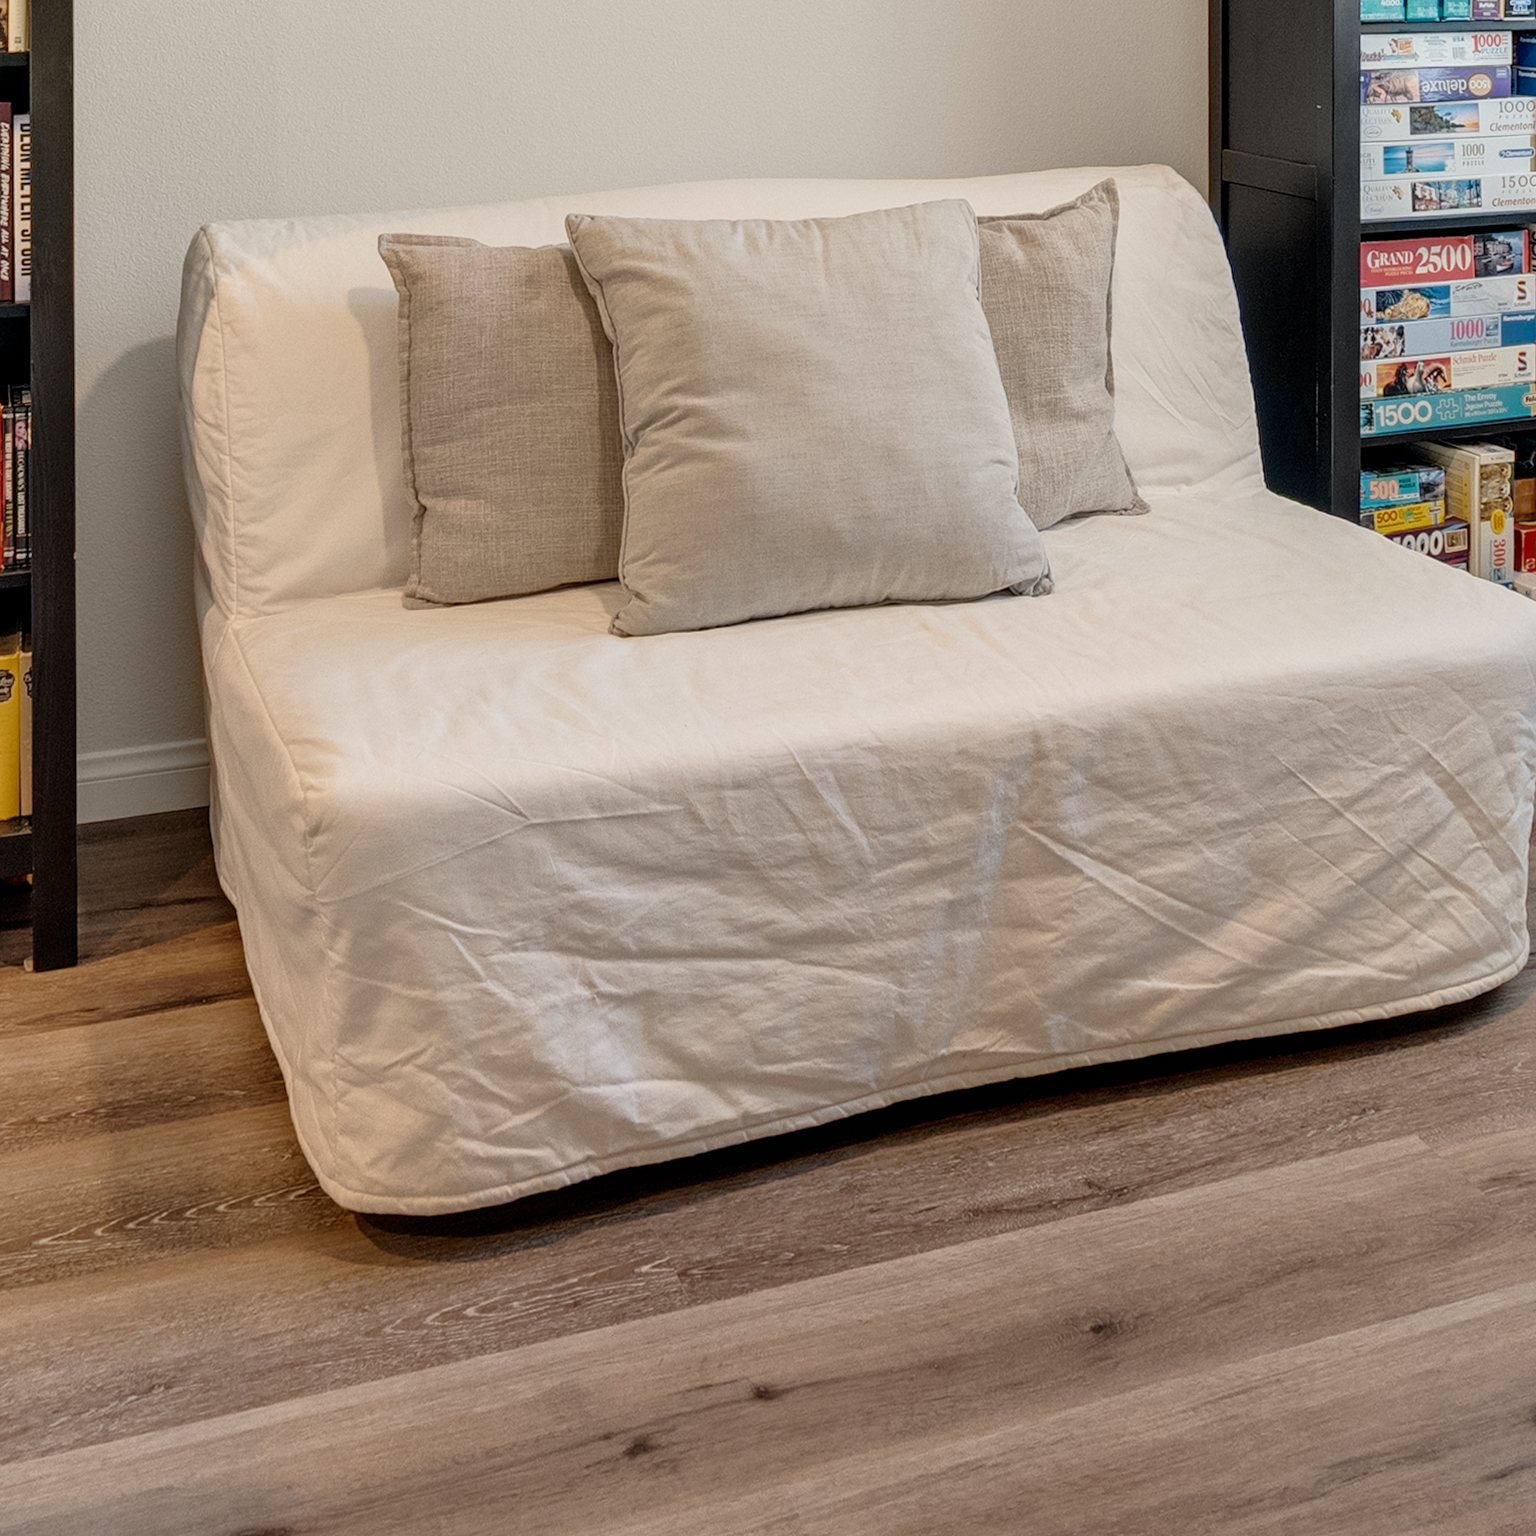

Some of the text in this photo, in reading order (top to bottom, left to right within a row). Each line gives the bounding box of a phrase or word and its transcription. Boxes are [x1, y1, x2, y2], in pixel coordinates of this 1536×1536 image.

[1422, 78, 1491, 93] deluxe 1500
[1490, 120, 1536, 132] Clementoni
[1367, 243, 1472, 274] GRAND 2500
[1453, 353, 1497, 364] Schmidt Puzzle
[1376, 400, 1433, 427] 1500
[1370, 479, 1399, 501] 500
[1493, 539, 1506, 567] 300
